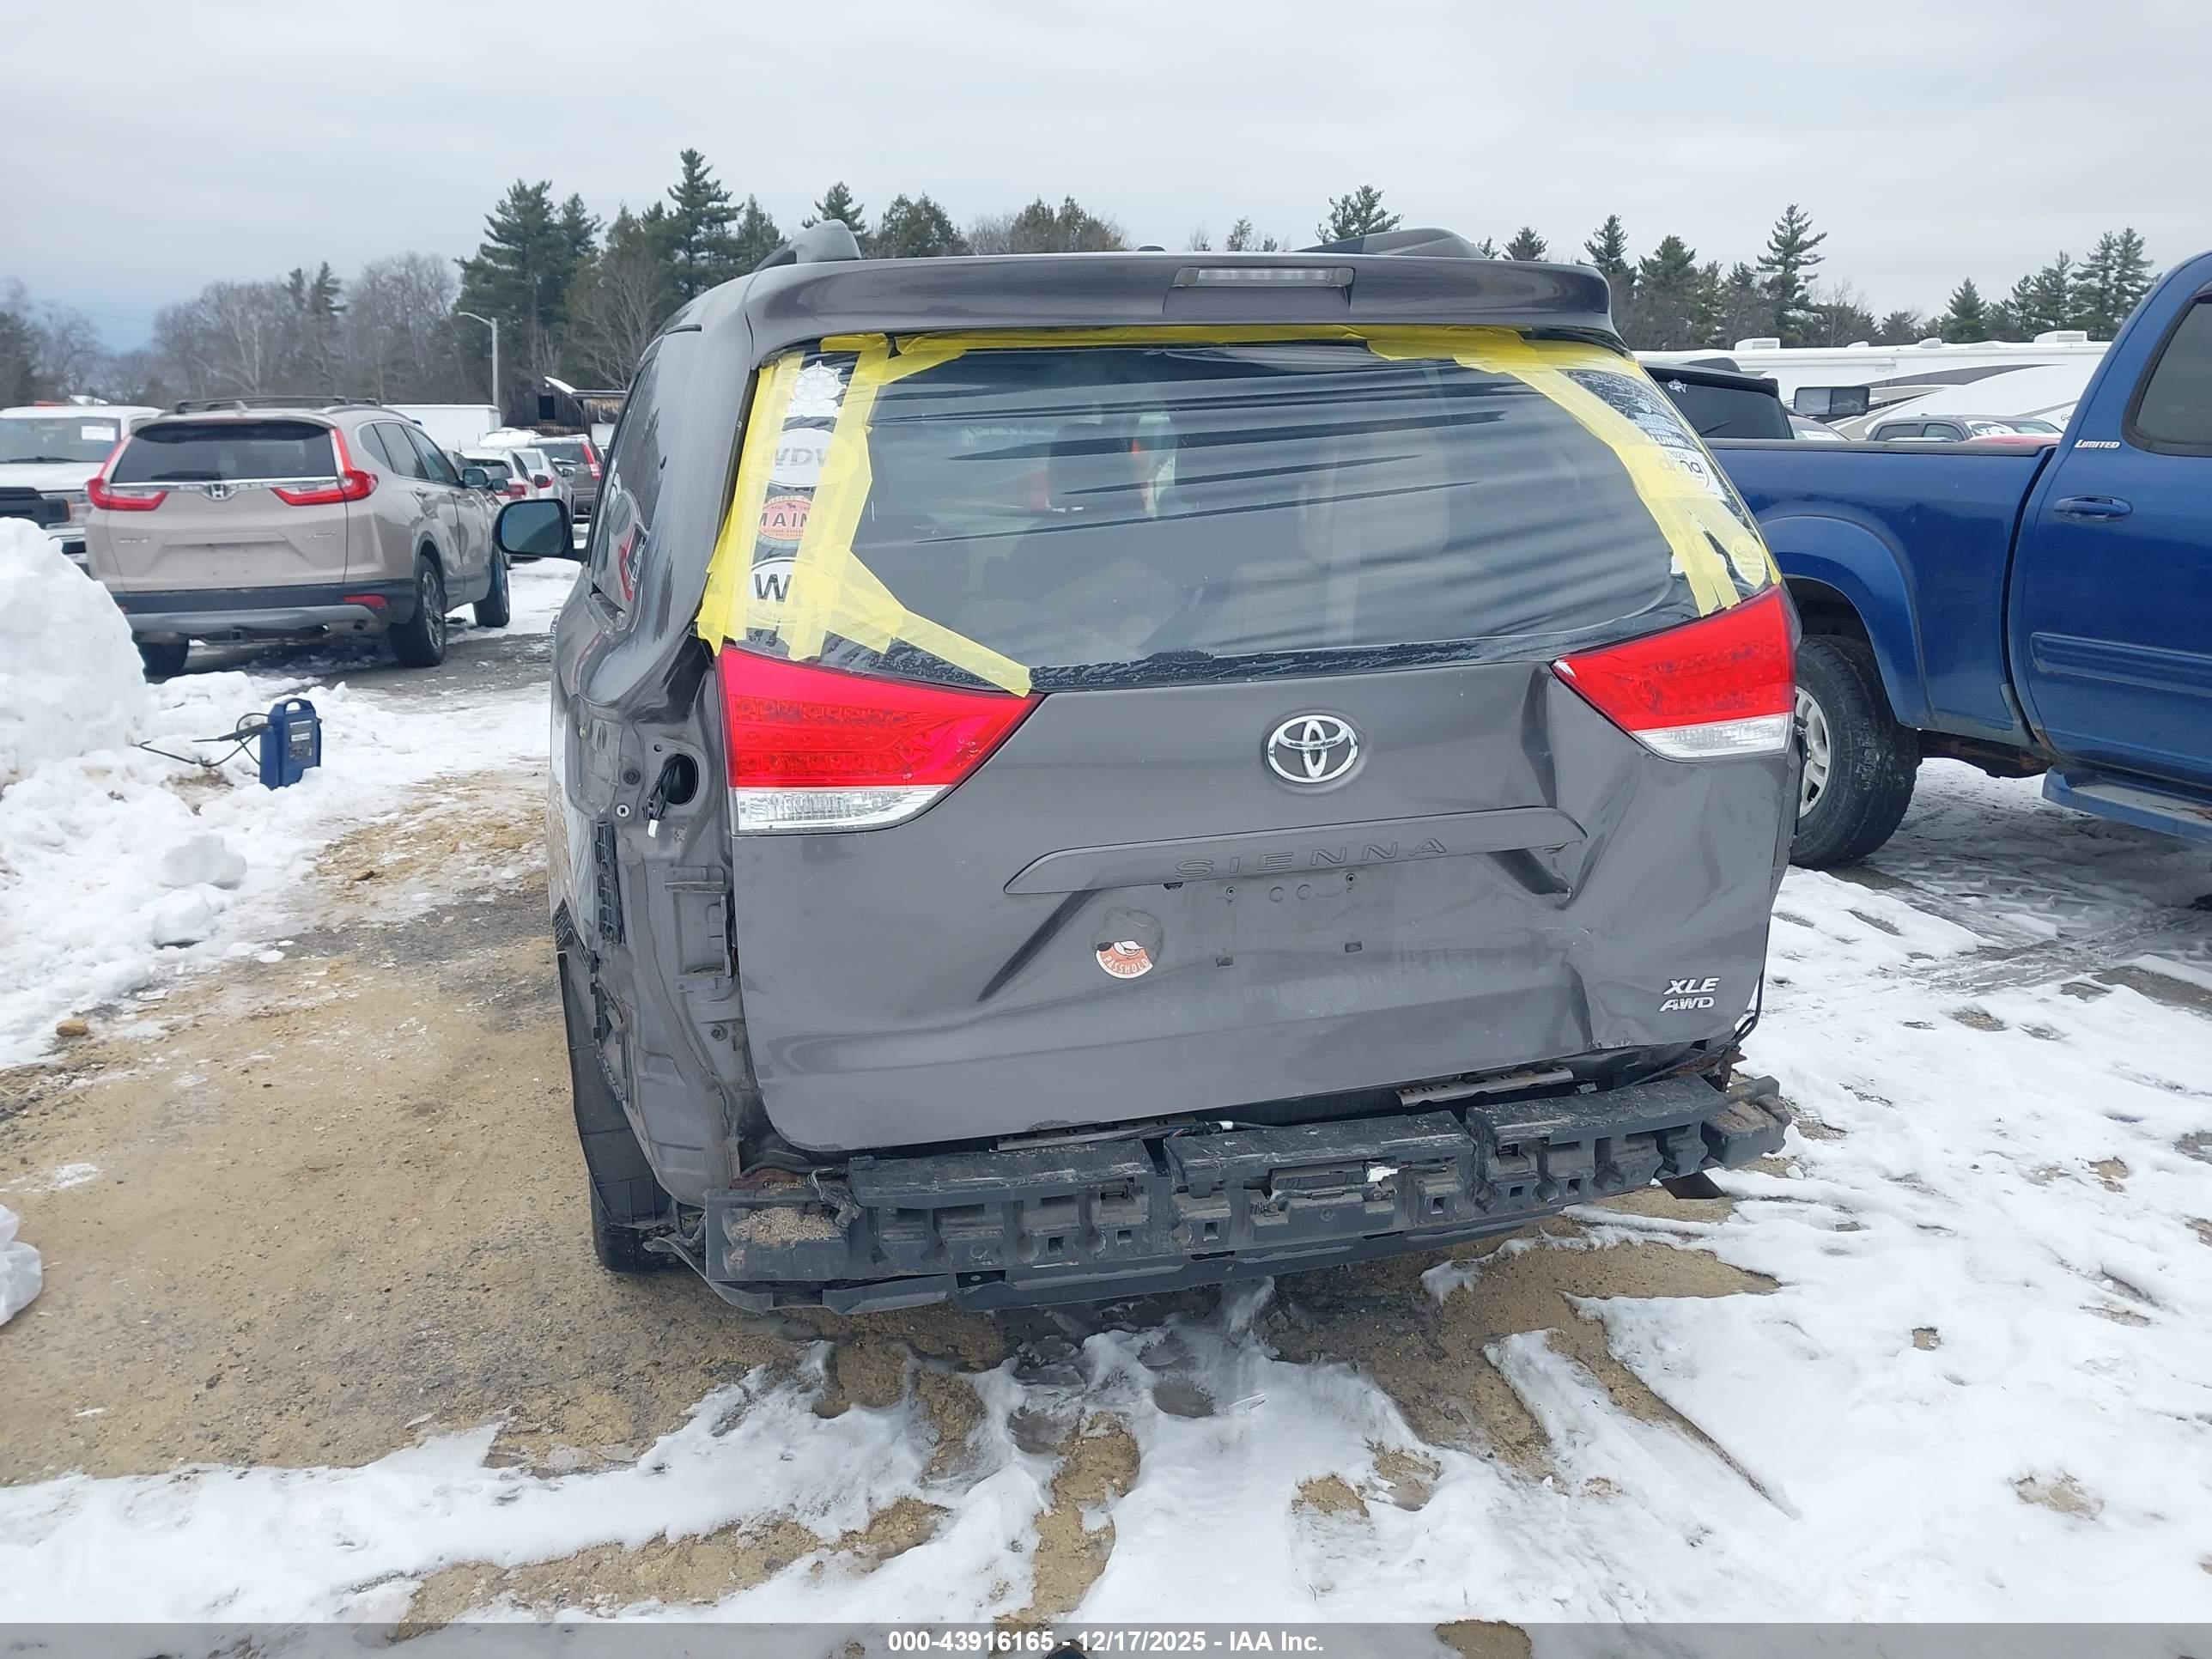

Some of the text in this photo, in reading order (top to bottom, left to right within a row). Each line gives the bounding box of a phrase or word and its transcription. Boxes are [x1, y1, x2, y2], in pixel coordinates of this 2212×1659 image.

[2075, 439, 2121, 449] LIMITED
[1174, 836, 1448, 879] SIENNA
[1103, 955, 1150, 974] PASSHOLD
[1662, 977, 1721, 995] XLE
[1658, 996, 1715, 1012] AWD
